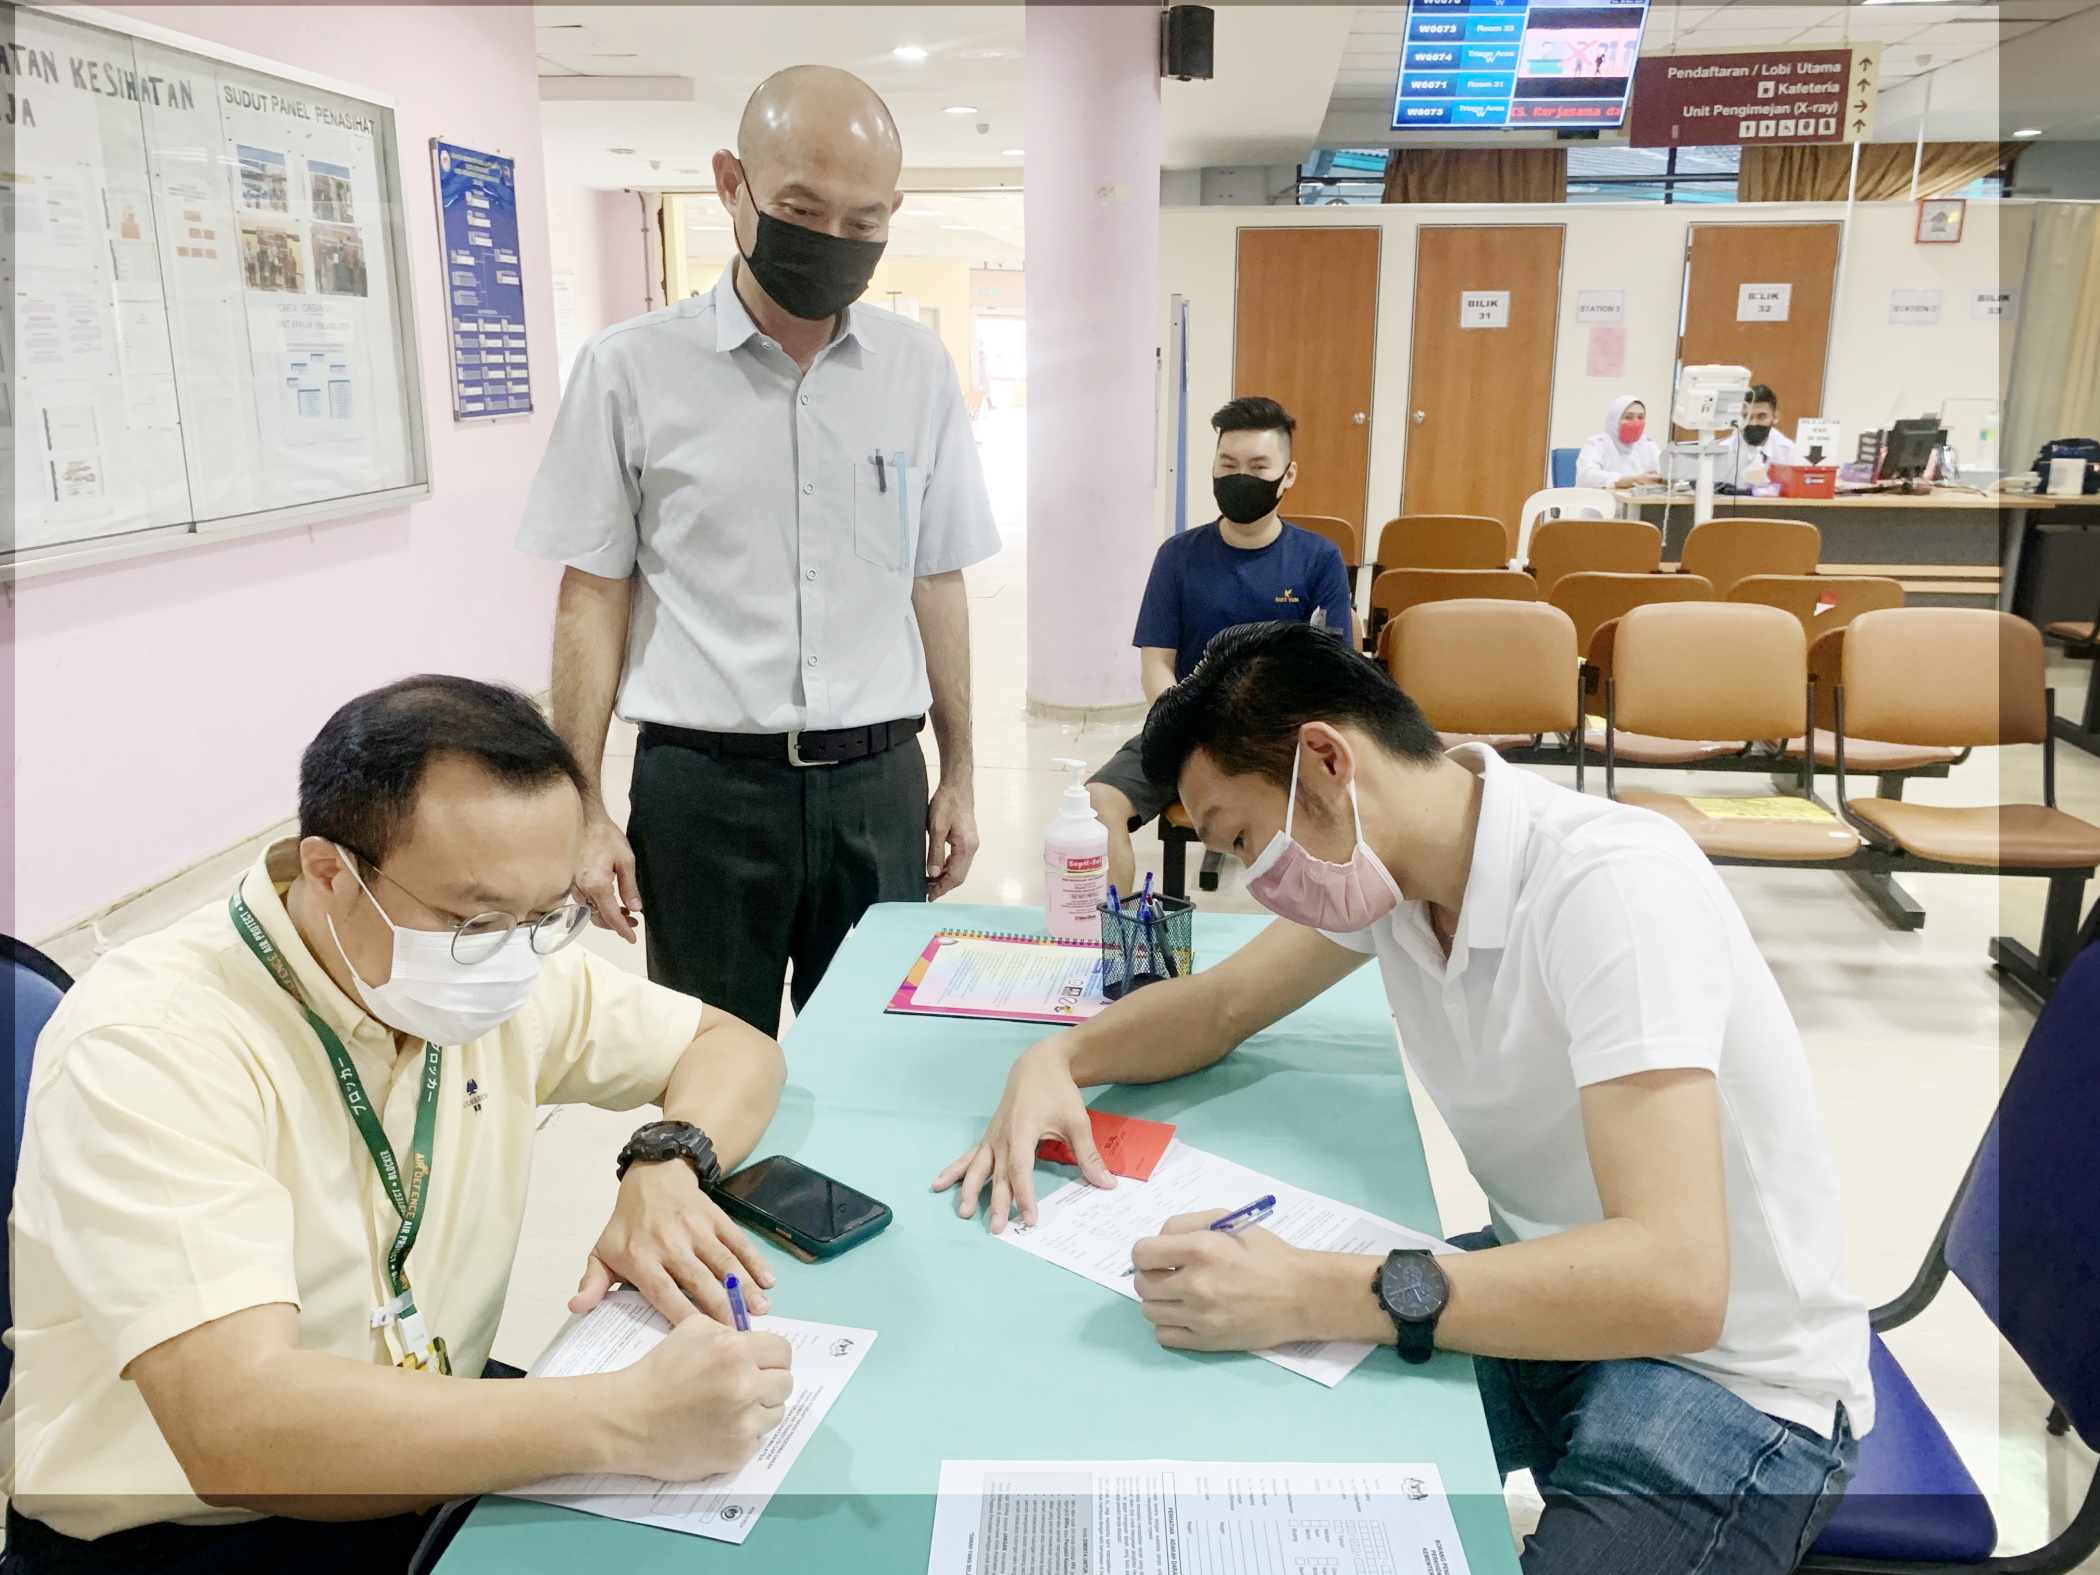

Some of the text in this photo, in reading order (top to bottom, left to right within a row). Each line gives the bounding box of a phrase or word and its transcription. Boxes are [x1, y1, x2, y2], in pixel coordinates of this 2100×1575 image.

[1418, 24, 1457, 34] W0073
[1476, 24, 1515, 32] Room 33
[1415, 53, 1453, 62] W0074
[1468, 50, 1494, 58] Triage
[1667, 62, 1842, 79] Pendaftaran / Lobi Utama
[69, 56, 195, 110] KESIHATAN
[1411, 80, 1447, 89] W0071
[1467, 80, 1504, 88] Room 31
[1777, 83, 1840, 95] Kafeteria
[0, 93, 36, 128] JA
[223, 85, 375, 135] SUDUT PANEL PENASIHAT
[1407, 107, 1443, 116] W0073
[1533, 106, 1601, 119] Kerjasama
[1683, 101, 1839, 118] Unit Pengimejan (X-ray)
[1467, 300, 1499, 308] BILIK
[1478, 312, 1491, 320] 31
[240, 911, 265, 942] PROTECT
[259, 938, 274, 954] AIR
[380, 1149, 398, 1181] BLOCKER
[406, 1153, 425, 1219] AIR DEFENCE
[401, 1220, 413, 1234] AIR
[758, 1439, 775, 1461] MALAYSIA
[1435, 1540, 1446, 1562] BORANG
